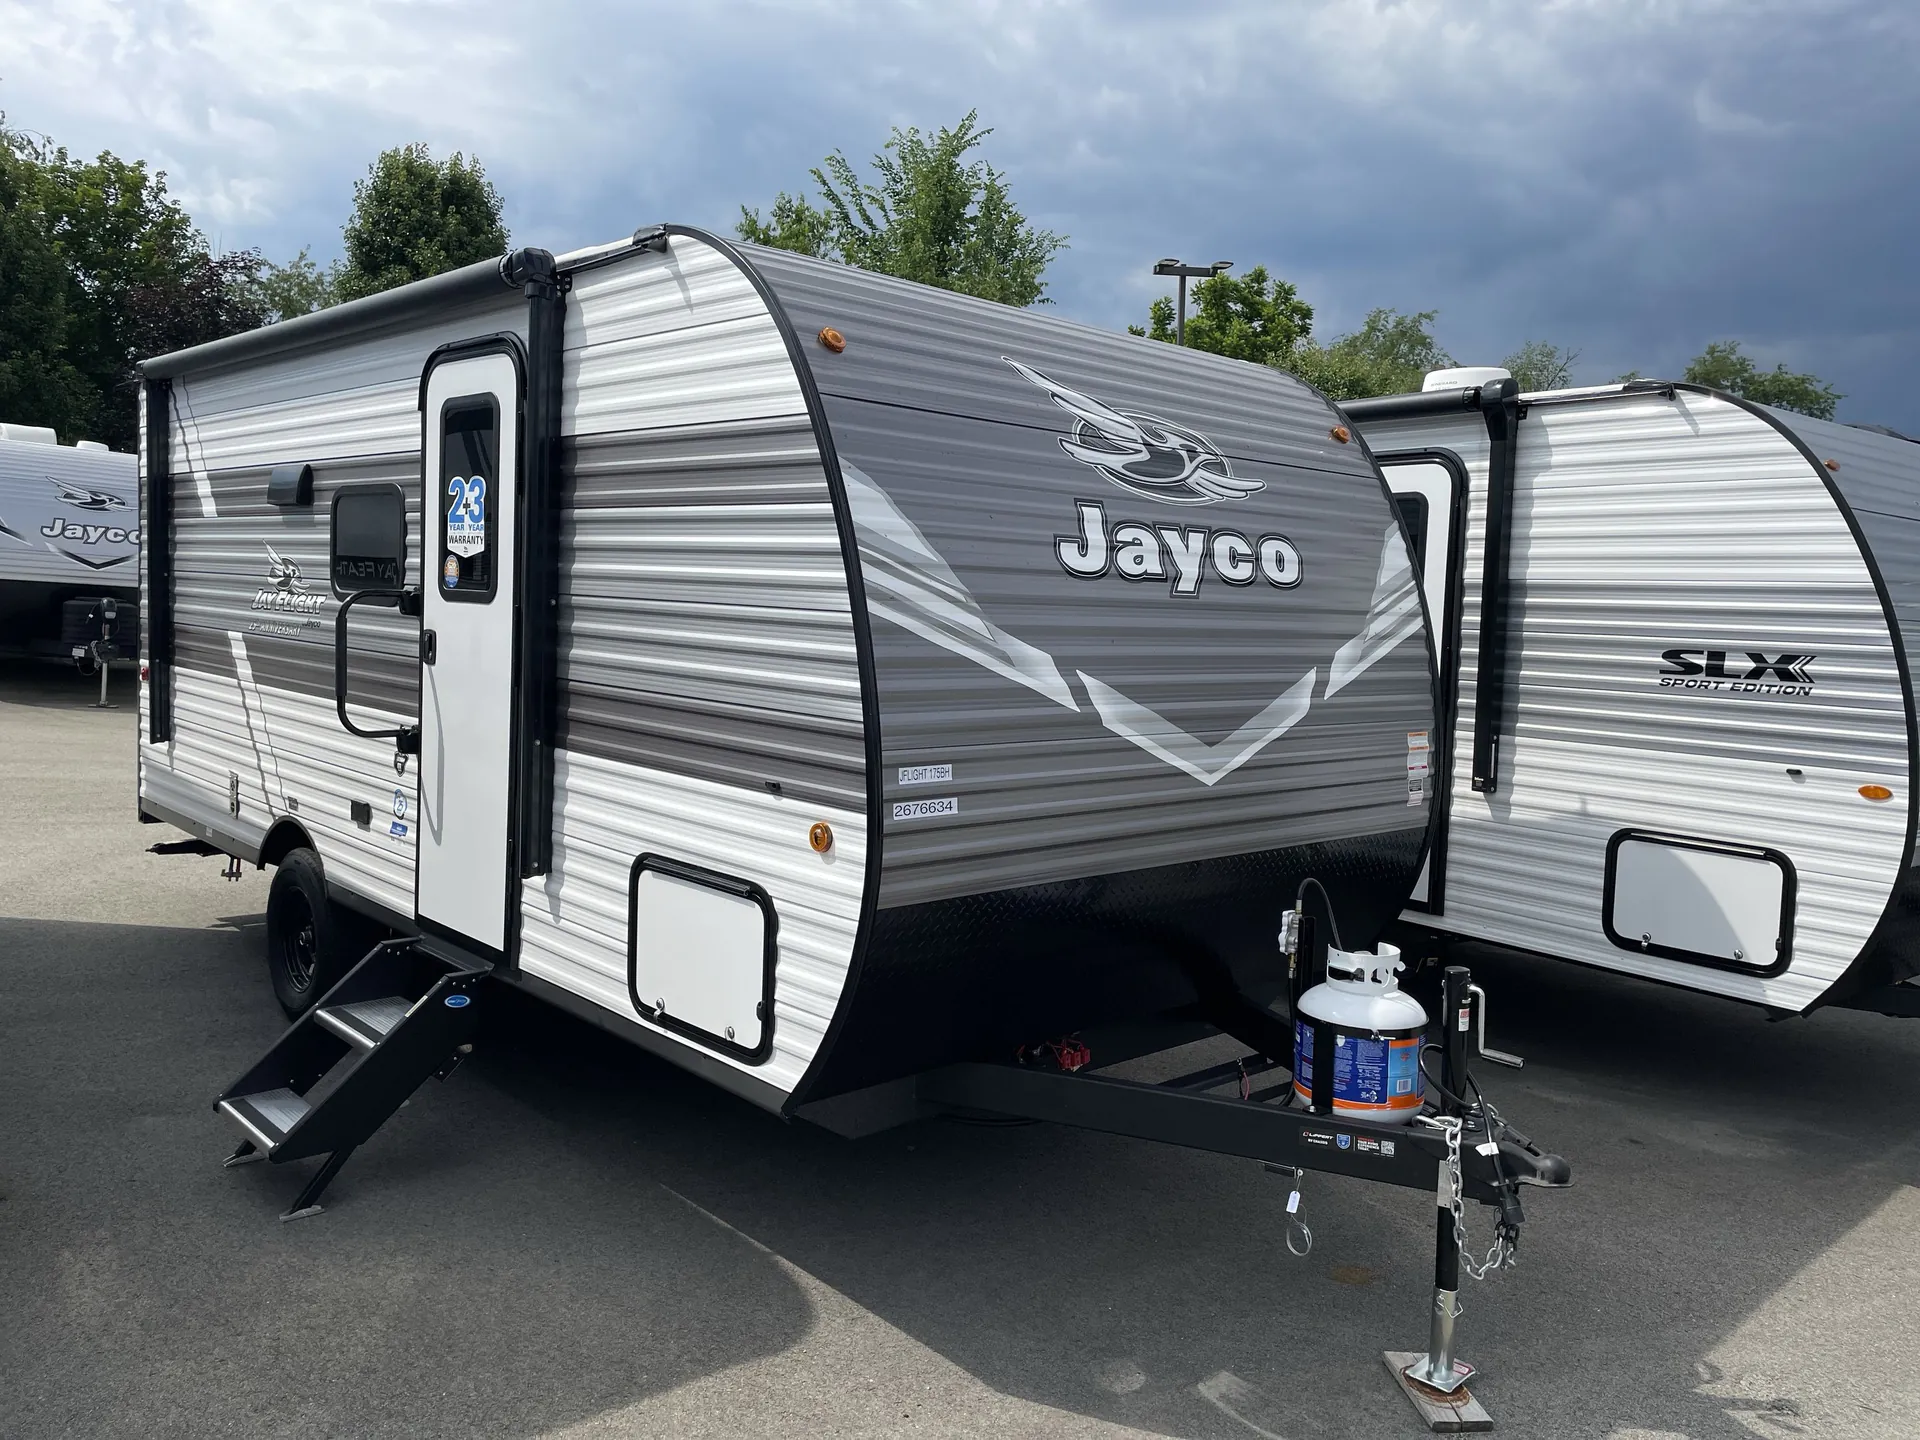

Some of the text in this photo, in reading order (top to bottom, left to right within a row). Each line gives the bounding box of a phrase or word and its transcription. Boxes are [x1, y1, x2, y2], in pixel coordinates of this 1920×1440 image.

[449, 523, 484, 531] YEAR YEAR
[449, 535, 484, 544] WARRANTY
[1053, 498, 1303, 600] Jayco
[251, 588, 327, 614] JAY FLIGHT
[1659, 650, 1817, 683] SLX
[1659, 678, 1813, 696] SPORT EDITION
[900, 767, 949, 781] JFLIGHT 175BH
[895, 801, 953, 817] 2676634
